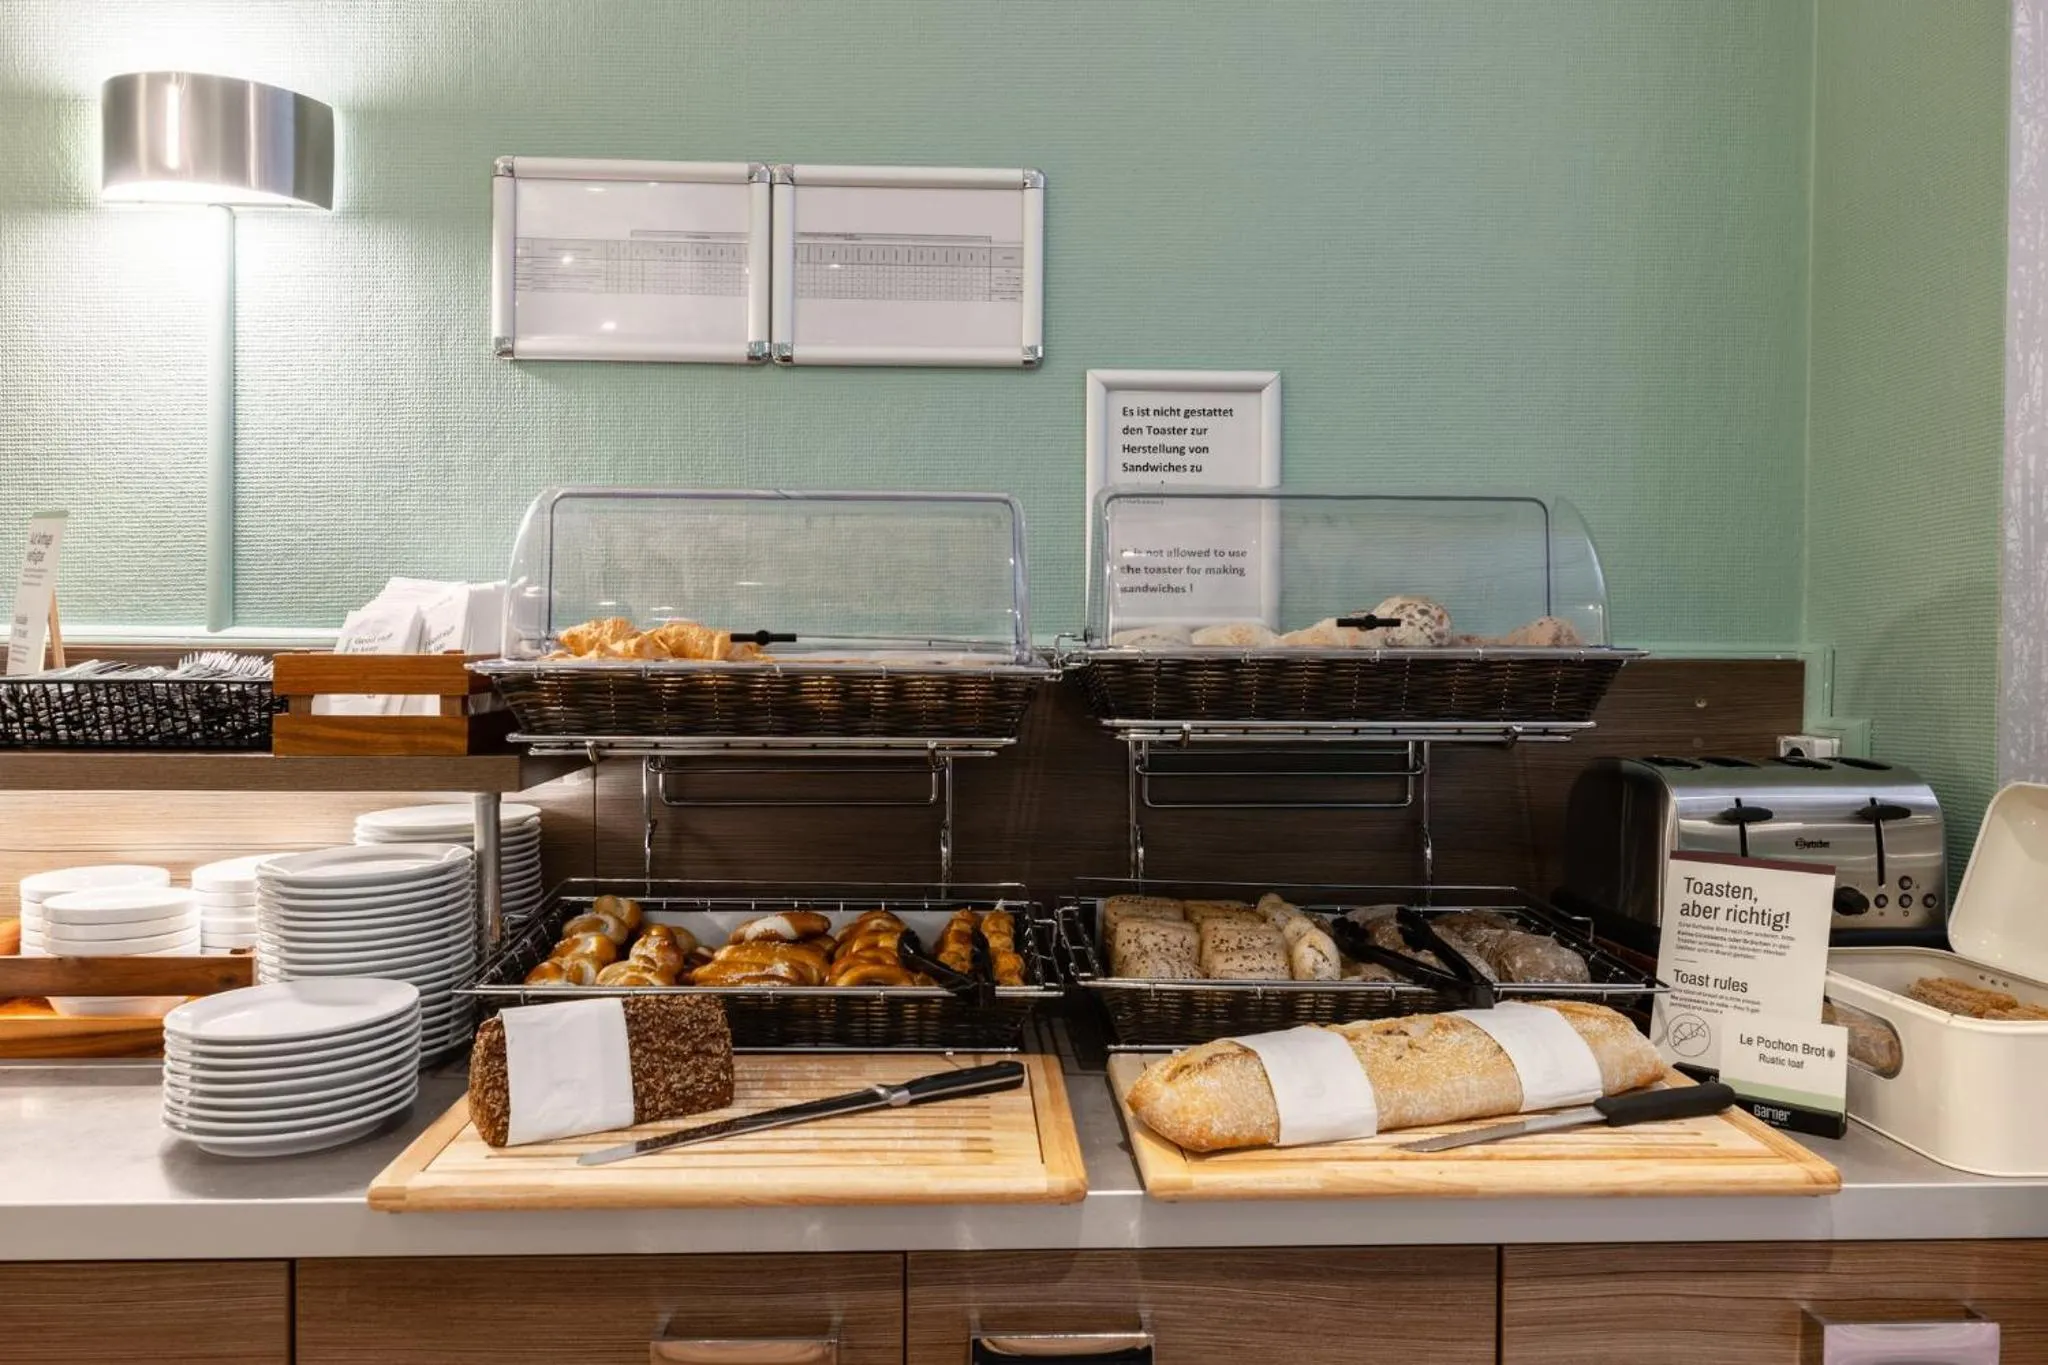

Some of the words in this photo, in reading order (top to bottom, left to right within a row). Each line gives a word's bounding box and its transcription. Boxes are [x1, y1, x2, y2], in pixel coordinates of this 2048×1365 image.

[1122, 406, 1134, 417] Es
[1137, 406, 1149, 417] ist
[1153, 406, 1181, 417] nicht
[1184, 407, 1234, 419] gestattet
[1122, 425, 1143, 435] den
[1146, 425, 1188, 435] Toaster
[1191, 427, 1208, 435] zur
[1122, 444, 1186, 456] Herstellung
[1189, 446, 1209, 454] von
[1122, 462, 1187, 473] Sandwiches
[1190, 464, 1203, 473] zu
[1167, 548, 1210, 558] allowed
[1214, 549, 1226, 558] to
[1144, 565, 1182, 574] toaster
[1186, 565, 1200, 574] for
[1205, 565, 1246, 577] making
[1121, 583, 1186, 593] sandwiches
[1683, 877, 1758, 904] Toasten,
[1680, 900, 1721, 920] aber
[1725, 904, 1791, 932] richtig!
[1673, 968, 1710, 987] Toast
[1714, 976, 1749, 993] rules
[1740, 1033, 1753, 1045] Le
[1757, 1036, 1799, 1052] Pochon
[1801, 1043, 1825, 1058] Brot
[1759, 1053, 1786, 1066] Rustic
